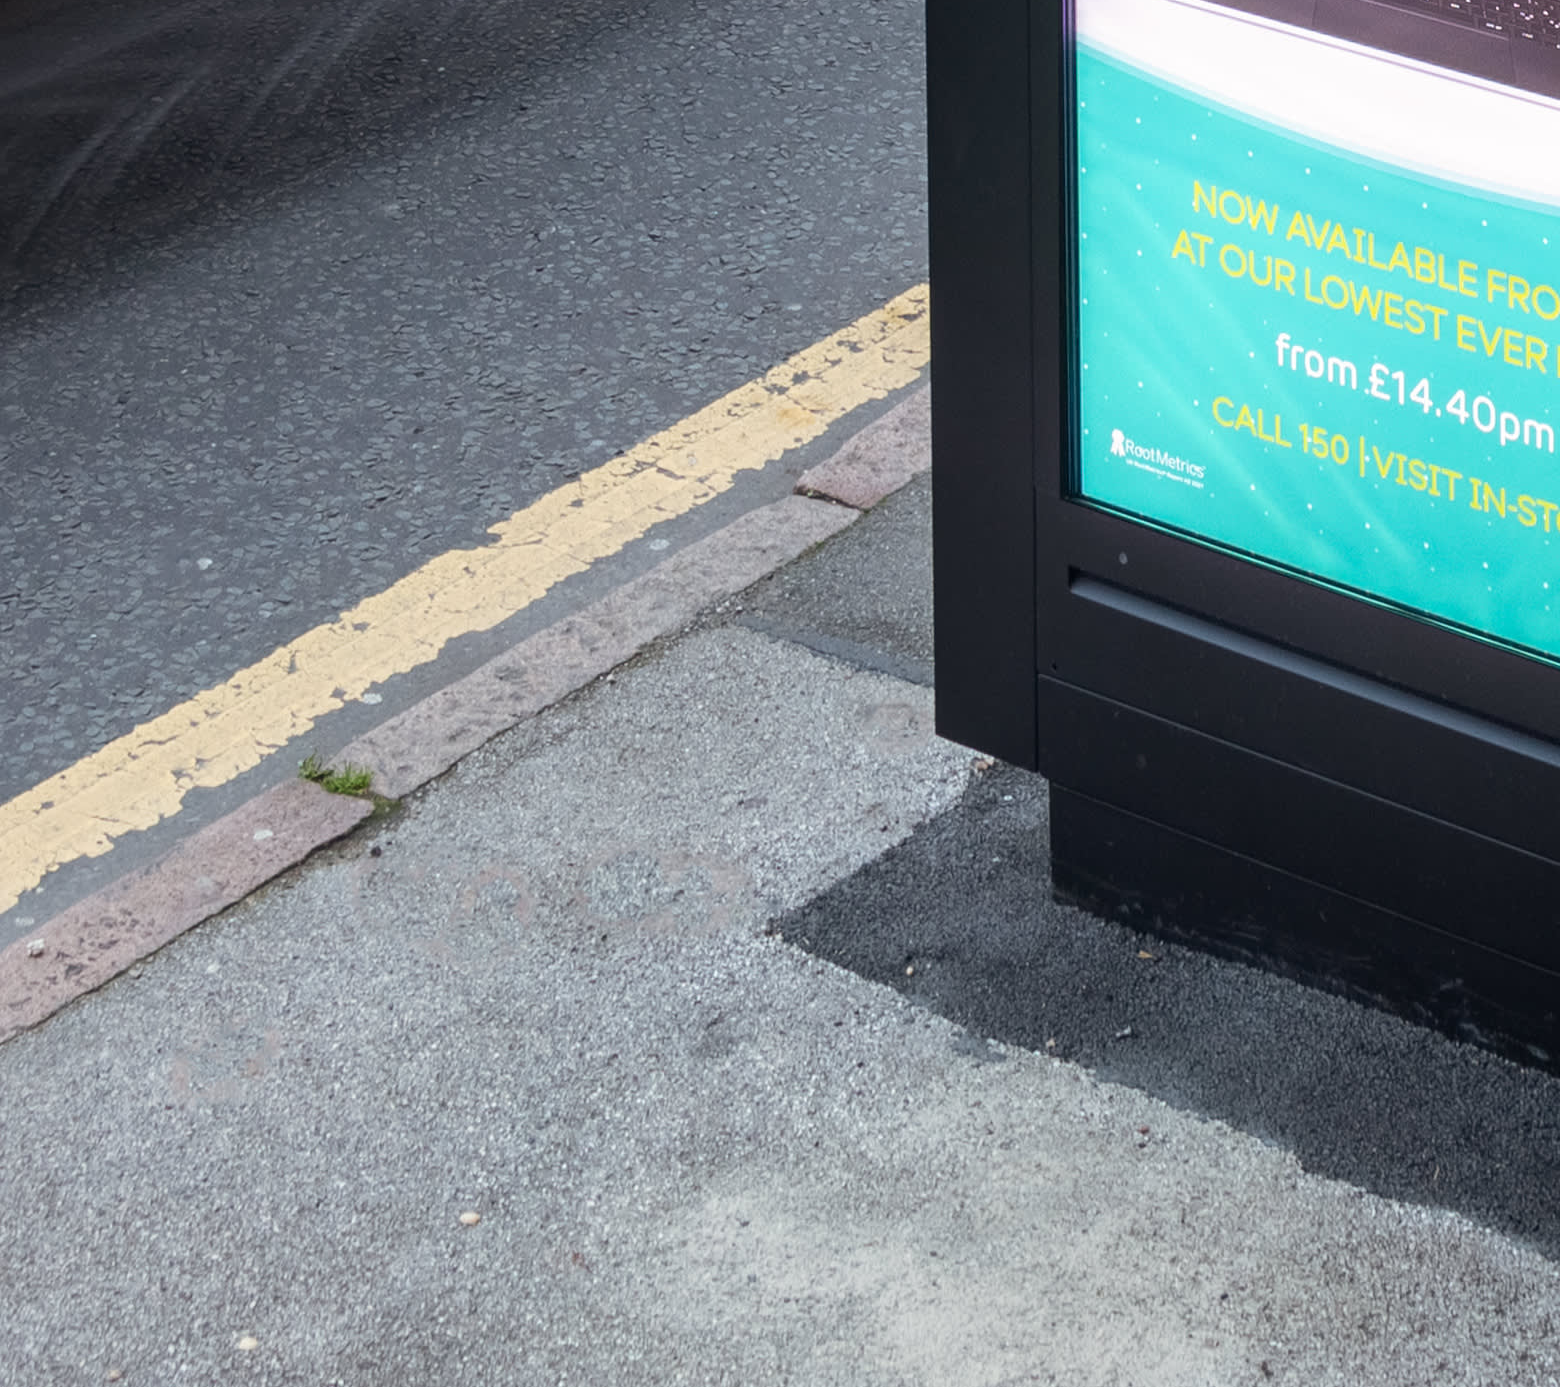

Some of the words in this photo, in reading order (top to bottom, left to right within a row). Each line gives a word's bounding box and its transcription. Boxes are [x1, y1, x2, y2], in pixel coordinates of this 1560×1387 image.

[1192, 181, 1279, 235] NOW
[1285, 211, 1478, 299] AVAILABLE
[1171, 231, 1213, 266] AT
[1219, 244, 1297, 296] OUR
[1304, 269, 1449, 342] LOWEST
[1456, 317, 1548, 373] EVER
[1212, 396, 1293, 450] CALL
[1299, 423, 1351, 466] 150
[1373, 451, 1462, 503] VISIT
[1275, 332, 1358, 391] from
[1369, 363, 1556, 453] £14.40pm
[1125, 437, 1204, 479] RootMetrics
